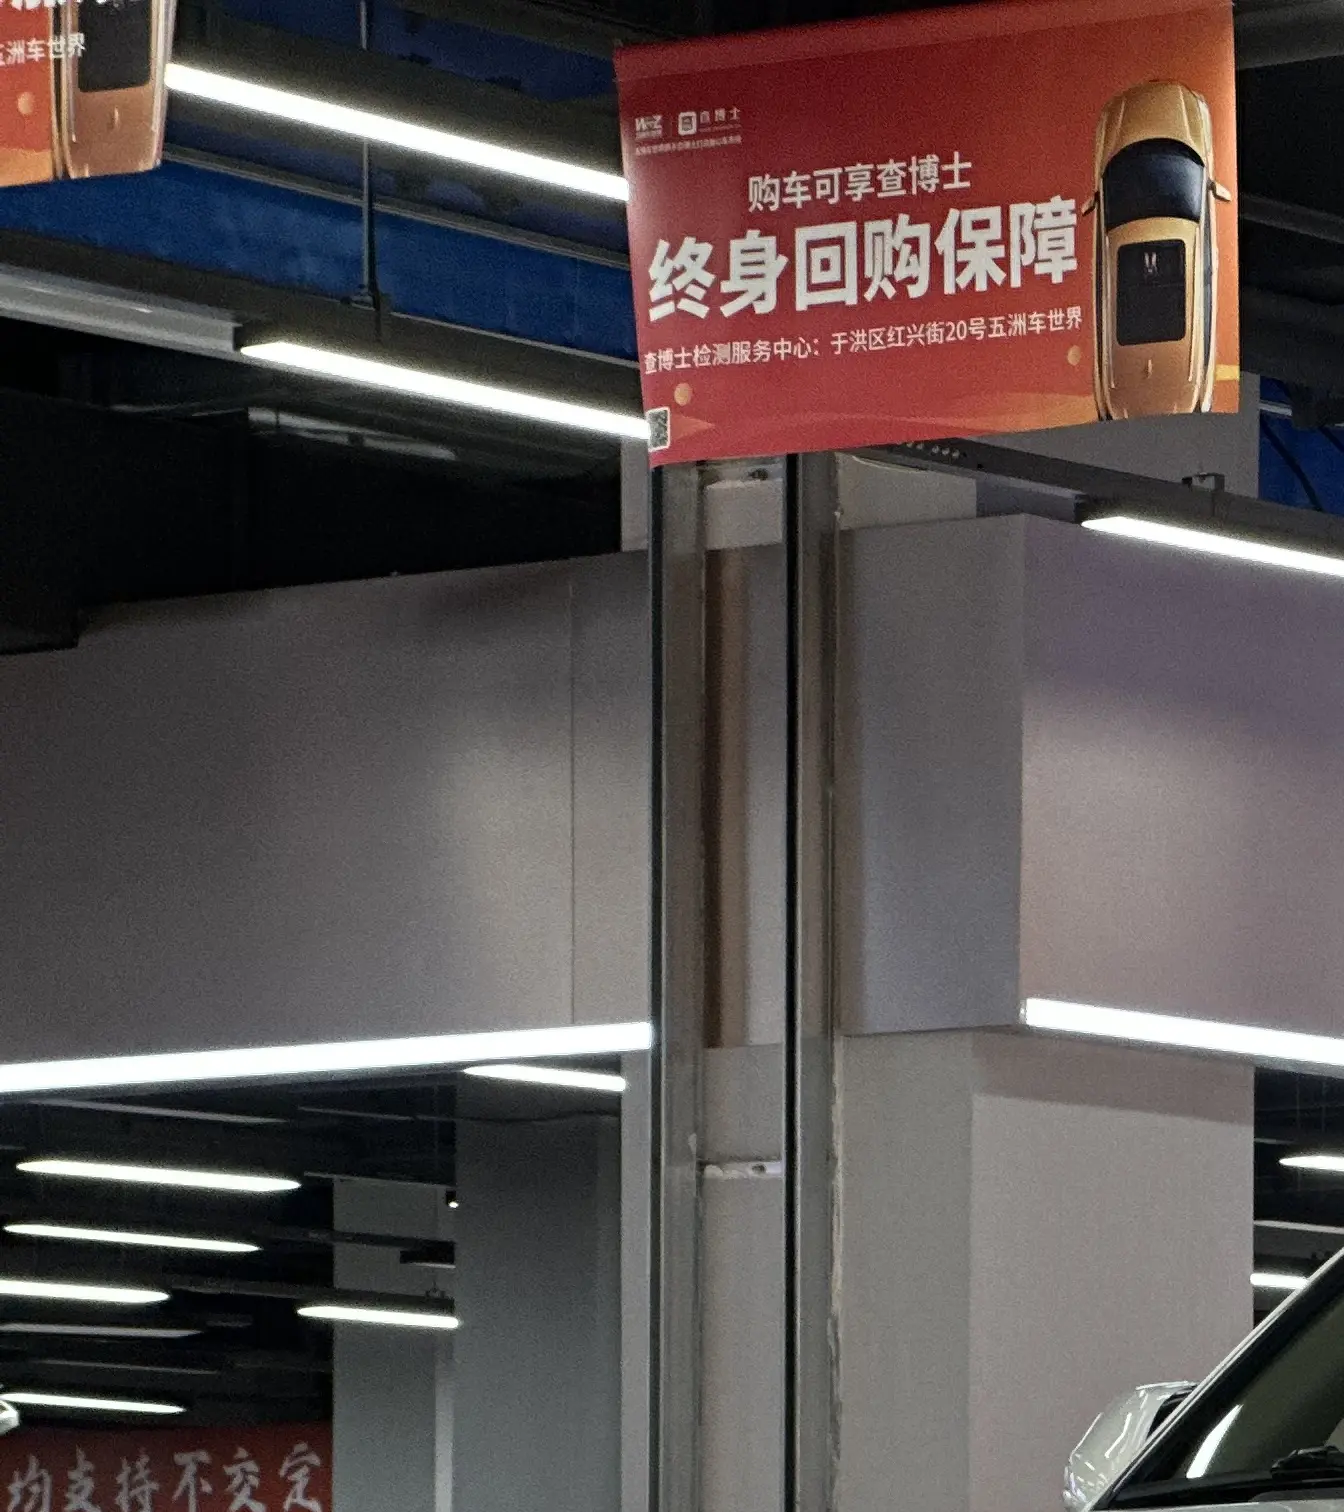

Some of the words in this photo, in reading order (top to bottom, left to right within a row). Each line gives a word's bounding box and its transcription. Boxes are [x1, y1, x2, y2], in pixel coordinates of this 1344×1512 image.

[748, 153, 973, 213] 购车可享查博士
[648, 195, 1079, 322] 终身回购保障
